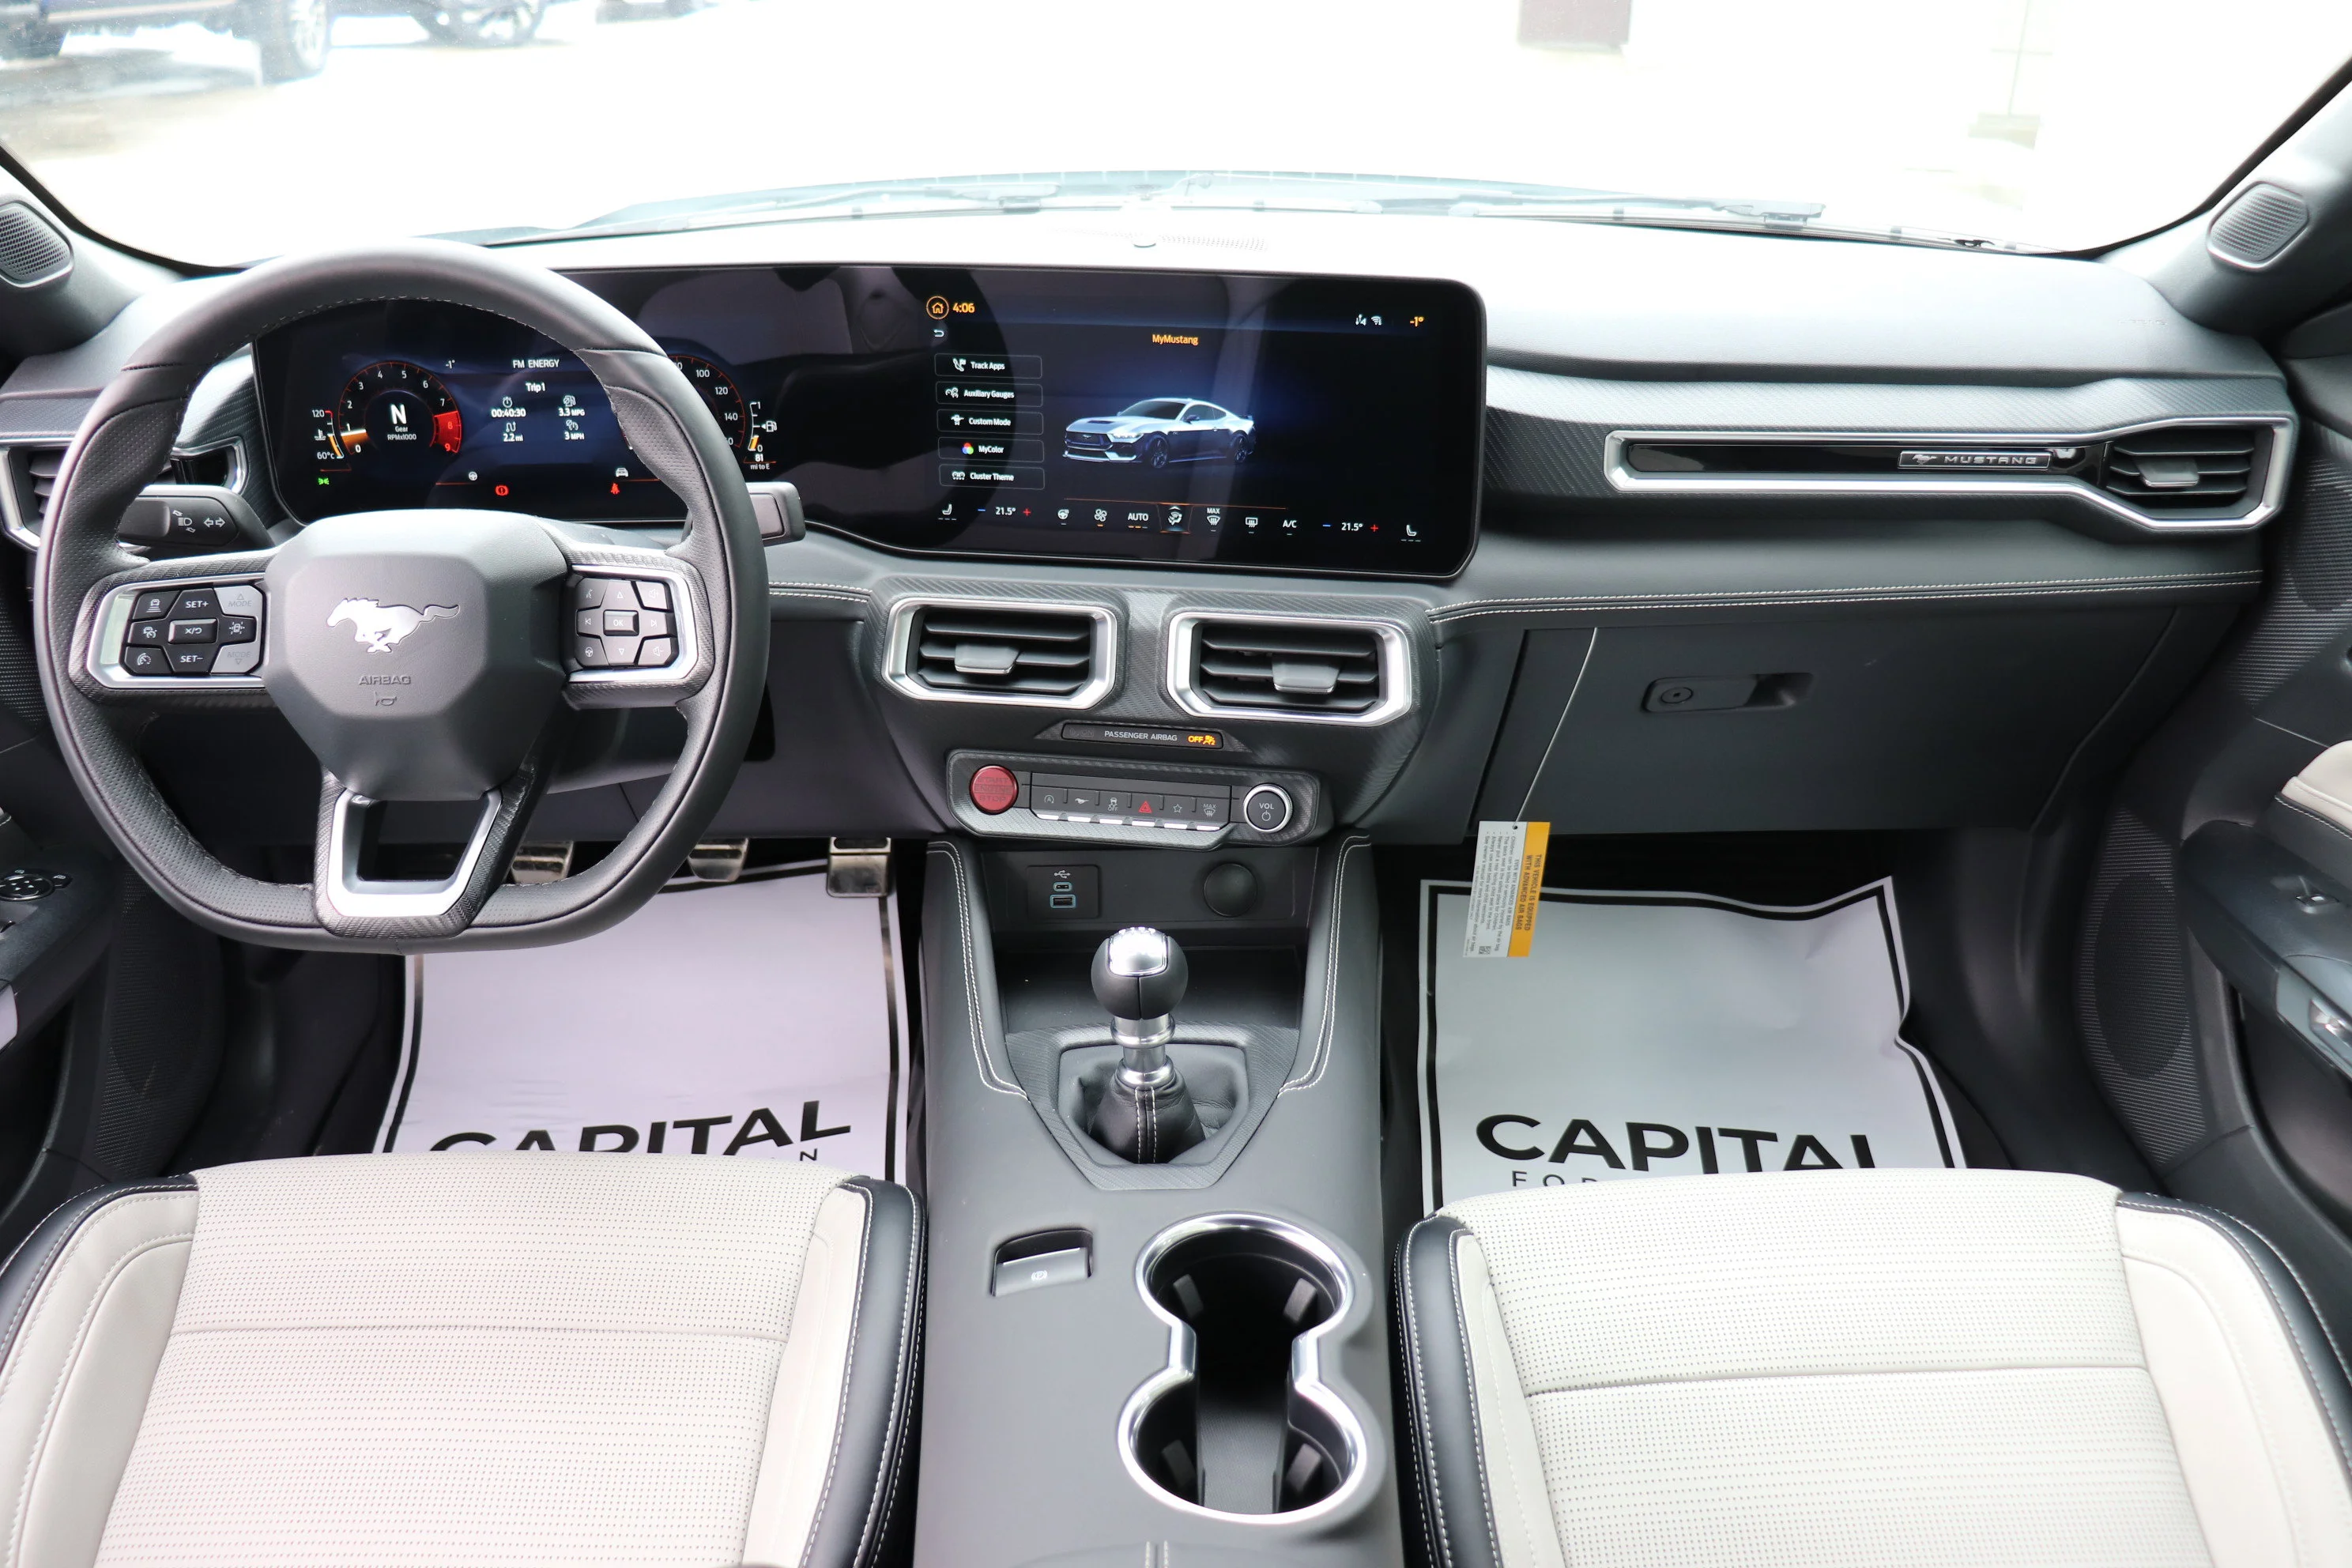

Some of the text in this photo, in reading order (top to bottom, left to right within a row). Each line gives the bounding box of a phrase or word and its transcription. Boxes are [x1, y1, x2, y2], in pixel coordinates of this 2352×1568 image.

[953, 302, 975, 313] 4:06
[1152, 334, 1199, 345] MyMustang
[513, 359, 560, 368] FM ENERGY
[696, 369, 710, 378] 100
[526, 383, 541, 392] Trip
[964, 390, 1014, 399] Auxiliary Gauges
[390, 404, 407, 424] N
[492, 409, 526, 418] 00:40:30
[559, 408, 570, 416] 3.3
[724, 413, 739, 421] 140
[503, 433, 514, 442] 2.2
[978, 445, 1004, 454] MyColor
[755, 454, 763, 462] 81
[1944, 456, 2037, 465] MUSTANG
[1128, 513, 1148, 521] AUTO
[1282, 520, 1297, 528] A/C
[358, 675, 411, 686] AIRBAG
[1104, 730, 1148, 740] PASSENGER
[1524, 855, 1532, 870] WITH
[1530, 870, 1539, 893] VEHICLE
[1519, 872, 1530, 901] ADVANCED
[1524, 903, 1534, 930] EQUIPPED
